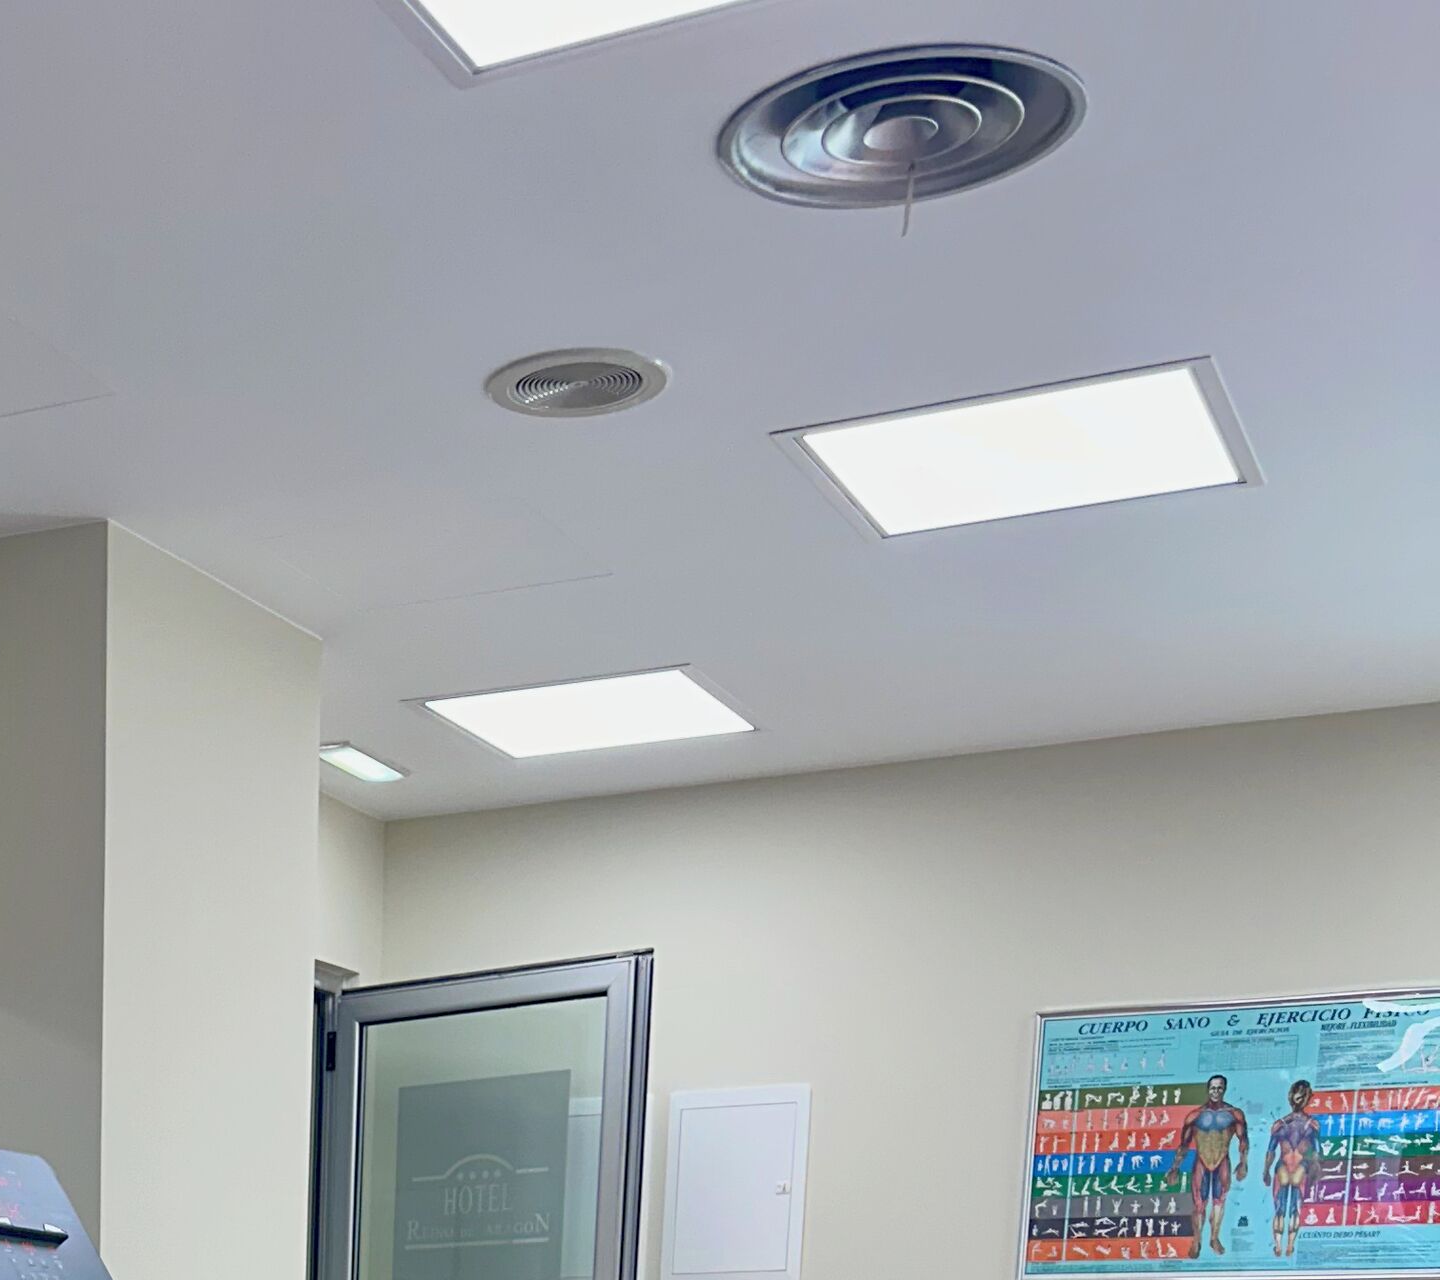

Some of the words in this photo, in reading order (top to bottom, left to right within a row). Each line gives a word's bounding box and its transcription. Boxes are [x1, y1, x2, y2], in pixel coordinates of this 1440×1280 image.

[1078, 1019, 1148, 1035] CUERPO
[1164, 1015, 1211, 1030] SANO
[1227, 1013, 1241, 1027] &
[1256, 1007, 1352, 1027] EJERCICIO
[443, 1183, 513, 1217] HOTEL
